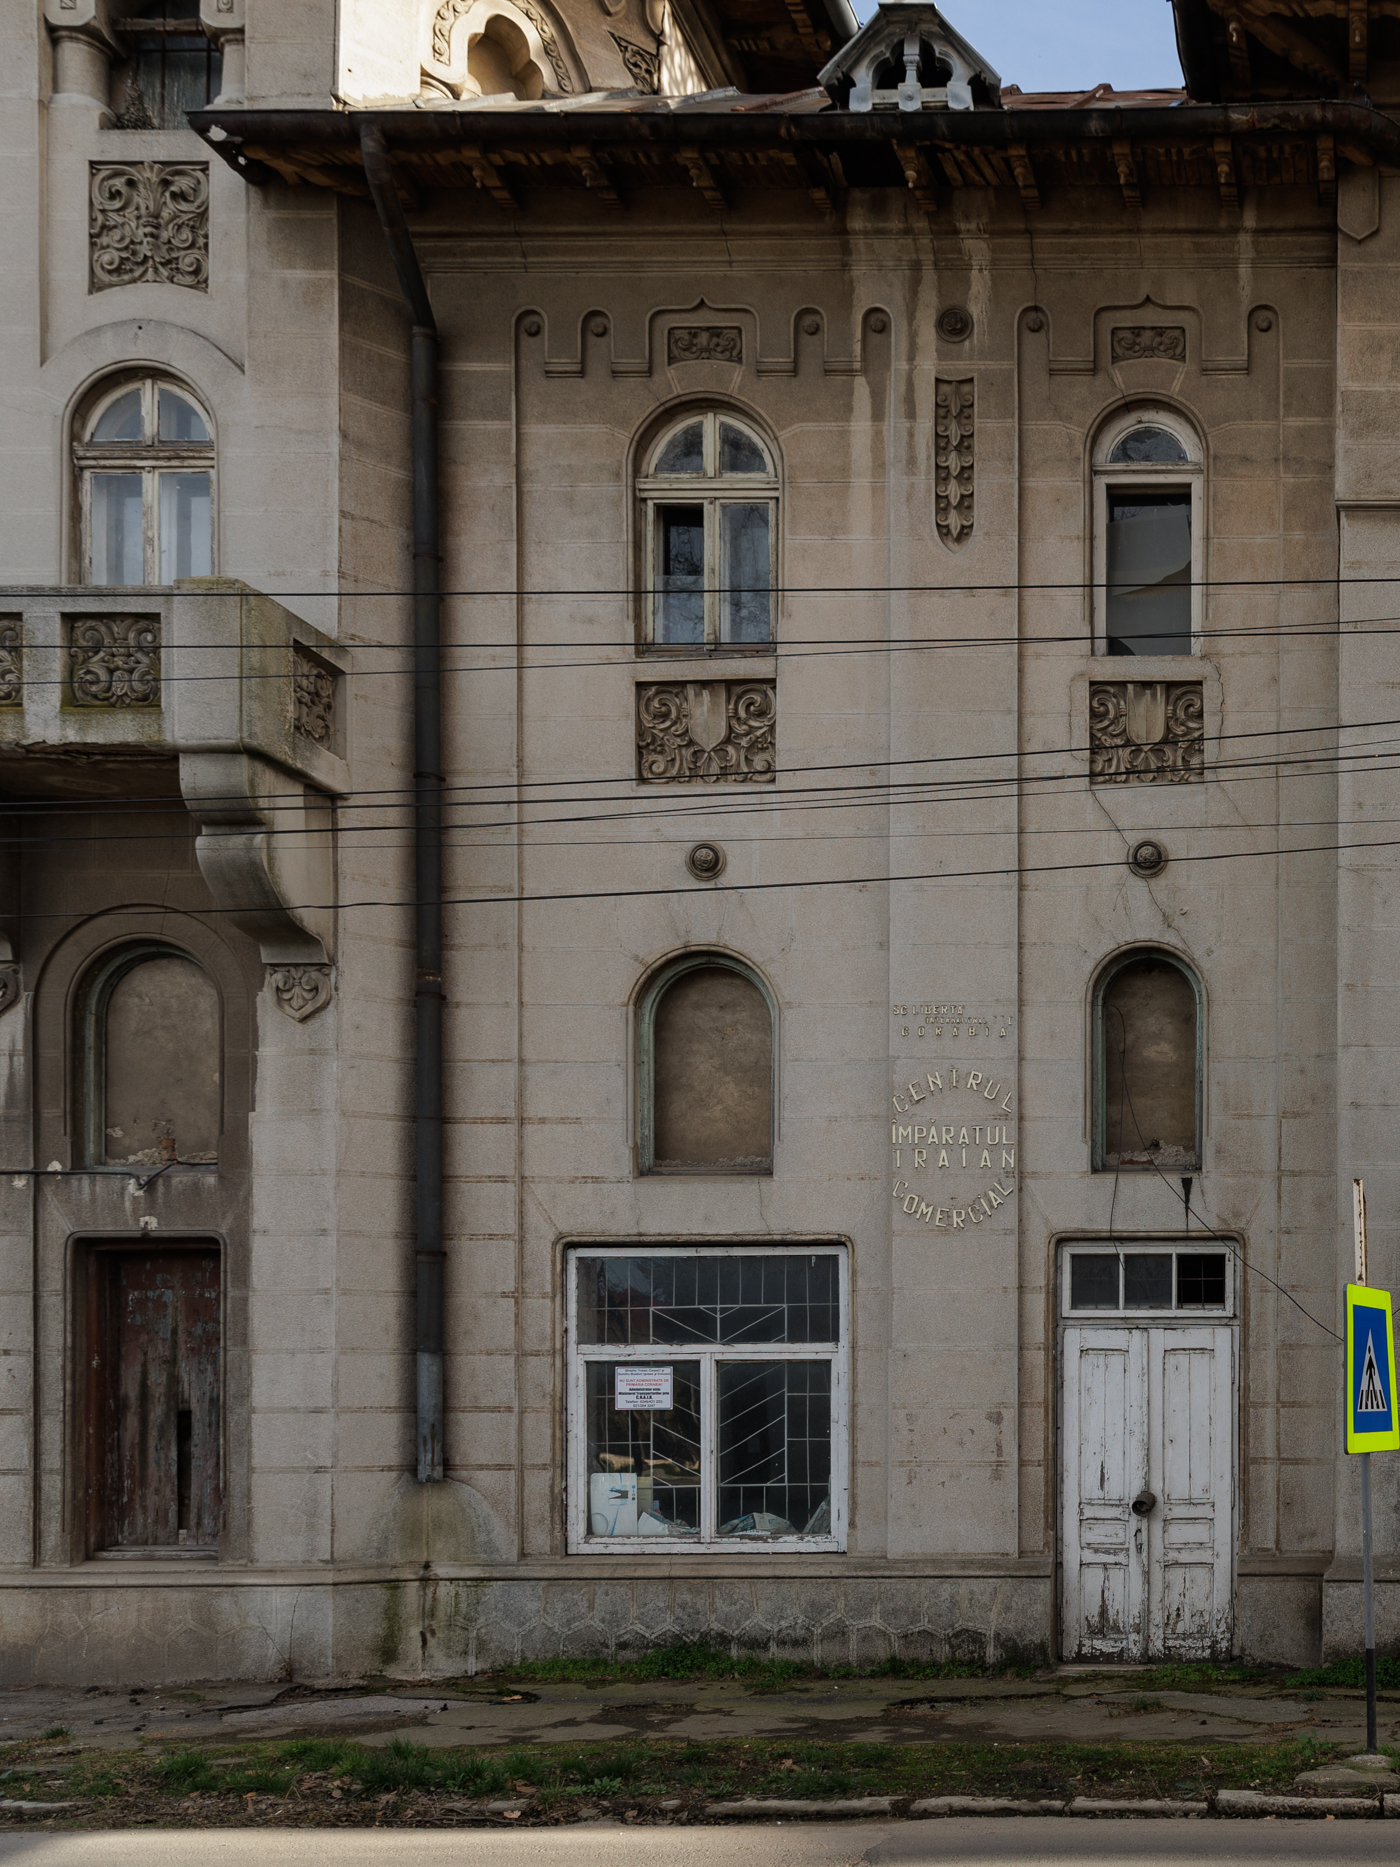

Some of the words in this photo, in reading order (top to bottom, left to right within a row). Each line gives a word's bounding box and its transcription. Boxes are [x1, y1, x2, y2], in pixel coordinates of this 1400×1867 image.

[893, 1004, 908, 1016] SC
[901, 1026, 1007, 1039] CORABIA
[891, 1068, 1013, 1114] CENTRUL
[891, 1118, 1015, 1146] ÎMPĂRATUL
[893, 1145, 1015, 1168] TRAIAN
[892, 1179, 1014, 1229] COMERCIAL
